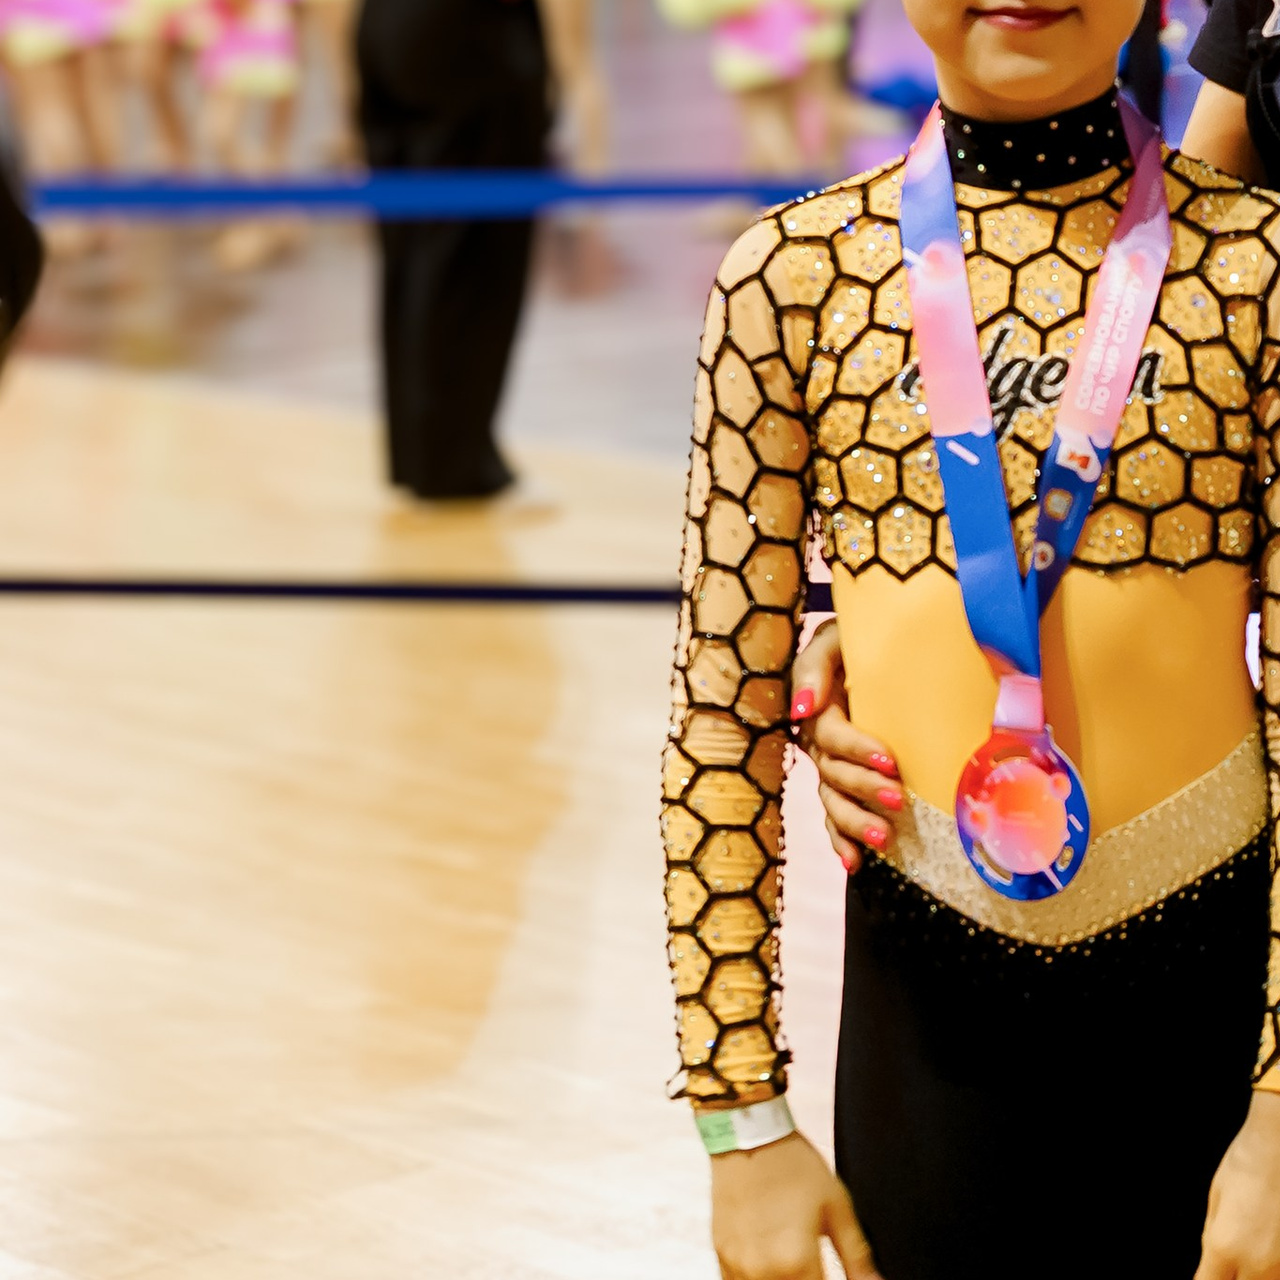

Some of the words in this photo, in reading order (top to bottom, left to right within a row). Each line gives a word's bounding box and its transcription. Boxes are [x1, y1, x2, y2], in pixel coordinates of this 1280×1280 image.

[1110, 272, 1146, 346] СПОРТУ
[1098, 344, 1124, 386] ЧИР
[1088, 384, 1112, 416] ПО
